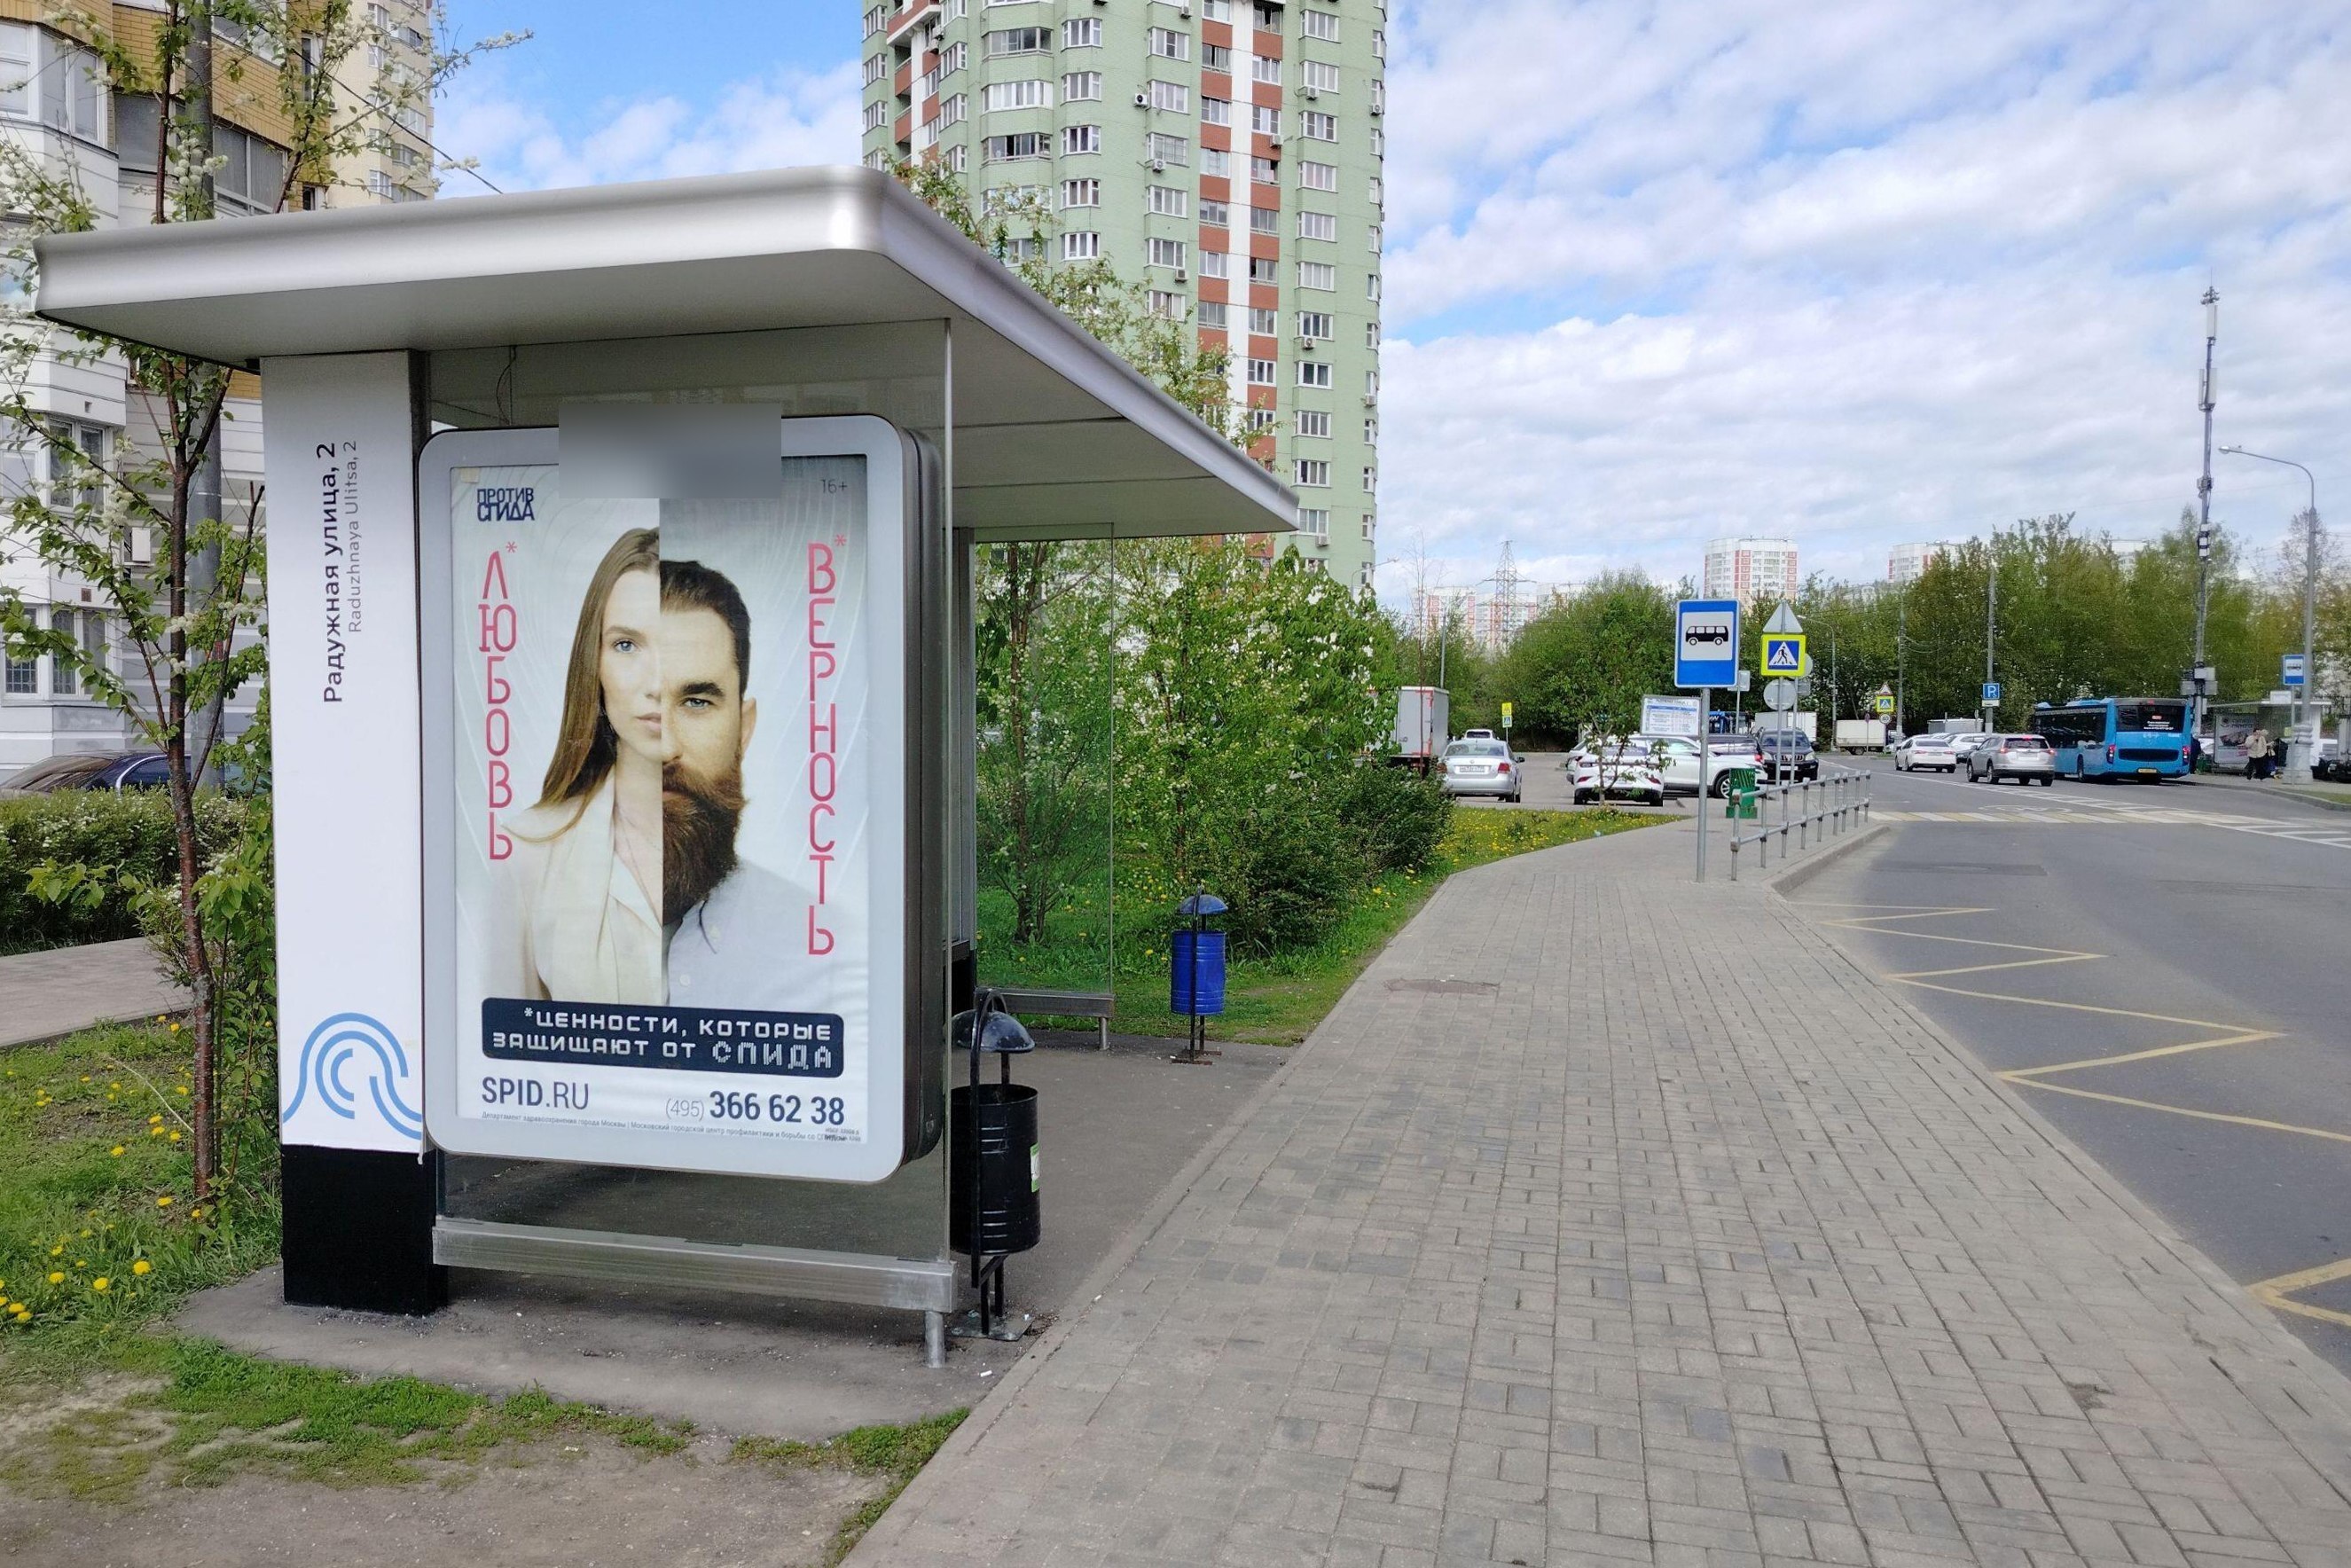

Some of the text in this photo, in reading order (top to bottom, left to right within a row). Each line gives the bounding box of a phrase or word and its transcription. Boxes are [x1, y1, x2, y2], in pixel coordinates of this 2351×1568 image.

[477, 488, 534, 503] ПРОТИВ
[819, 479, 848, 494] 16+
[477, 502, 535, 521] СПИДА
[342, 441, 363, 632] Raduzhnaya Ulitsa, 2
[316, 443, 346, 702] Радужная улица, 2
[699, 1019, 831, 1041] КОТОРЫЕ
[493, 1031, 832, 1070] ЗАЩИЩАЮТ ОТ СПИДА
[482, 1076, 589, 1109] SPID.RU
[666, 1090, 845, 1125] (495) 366 62 38
